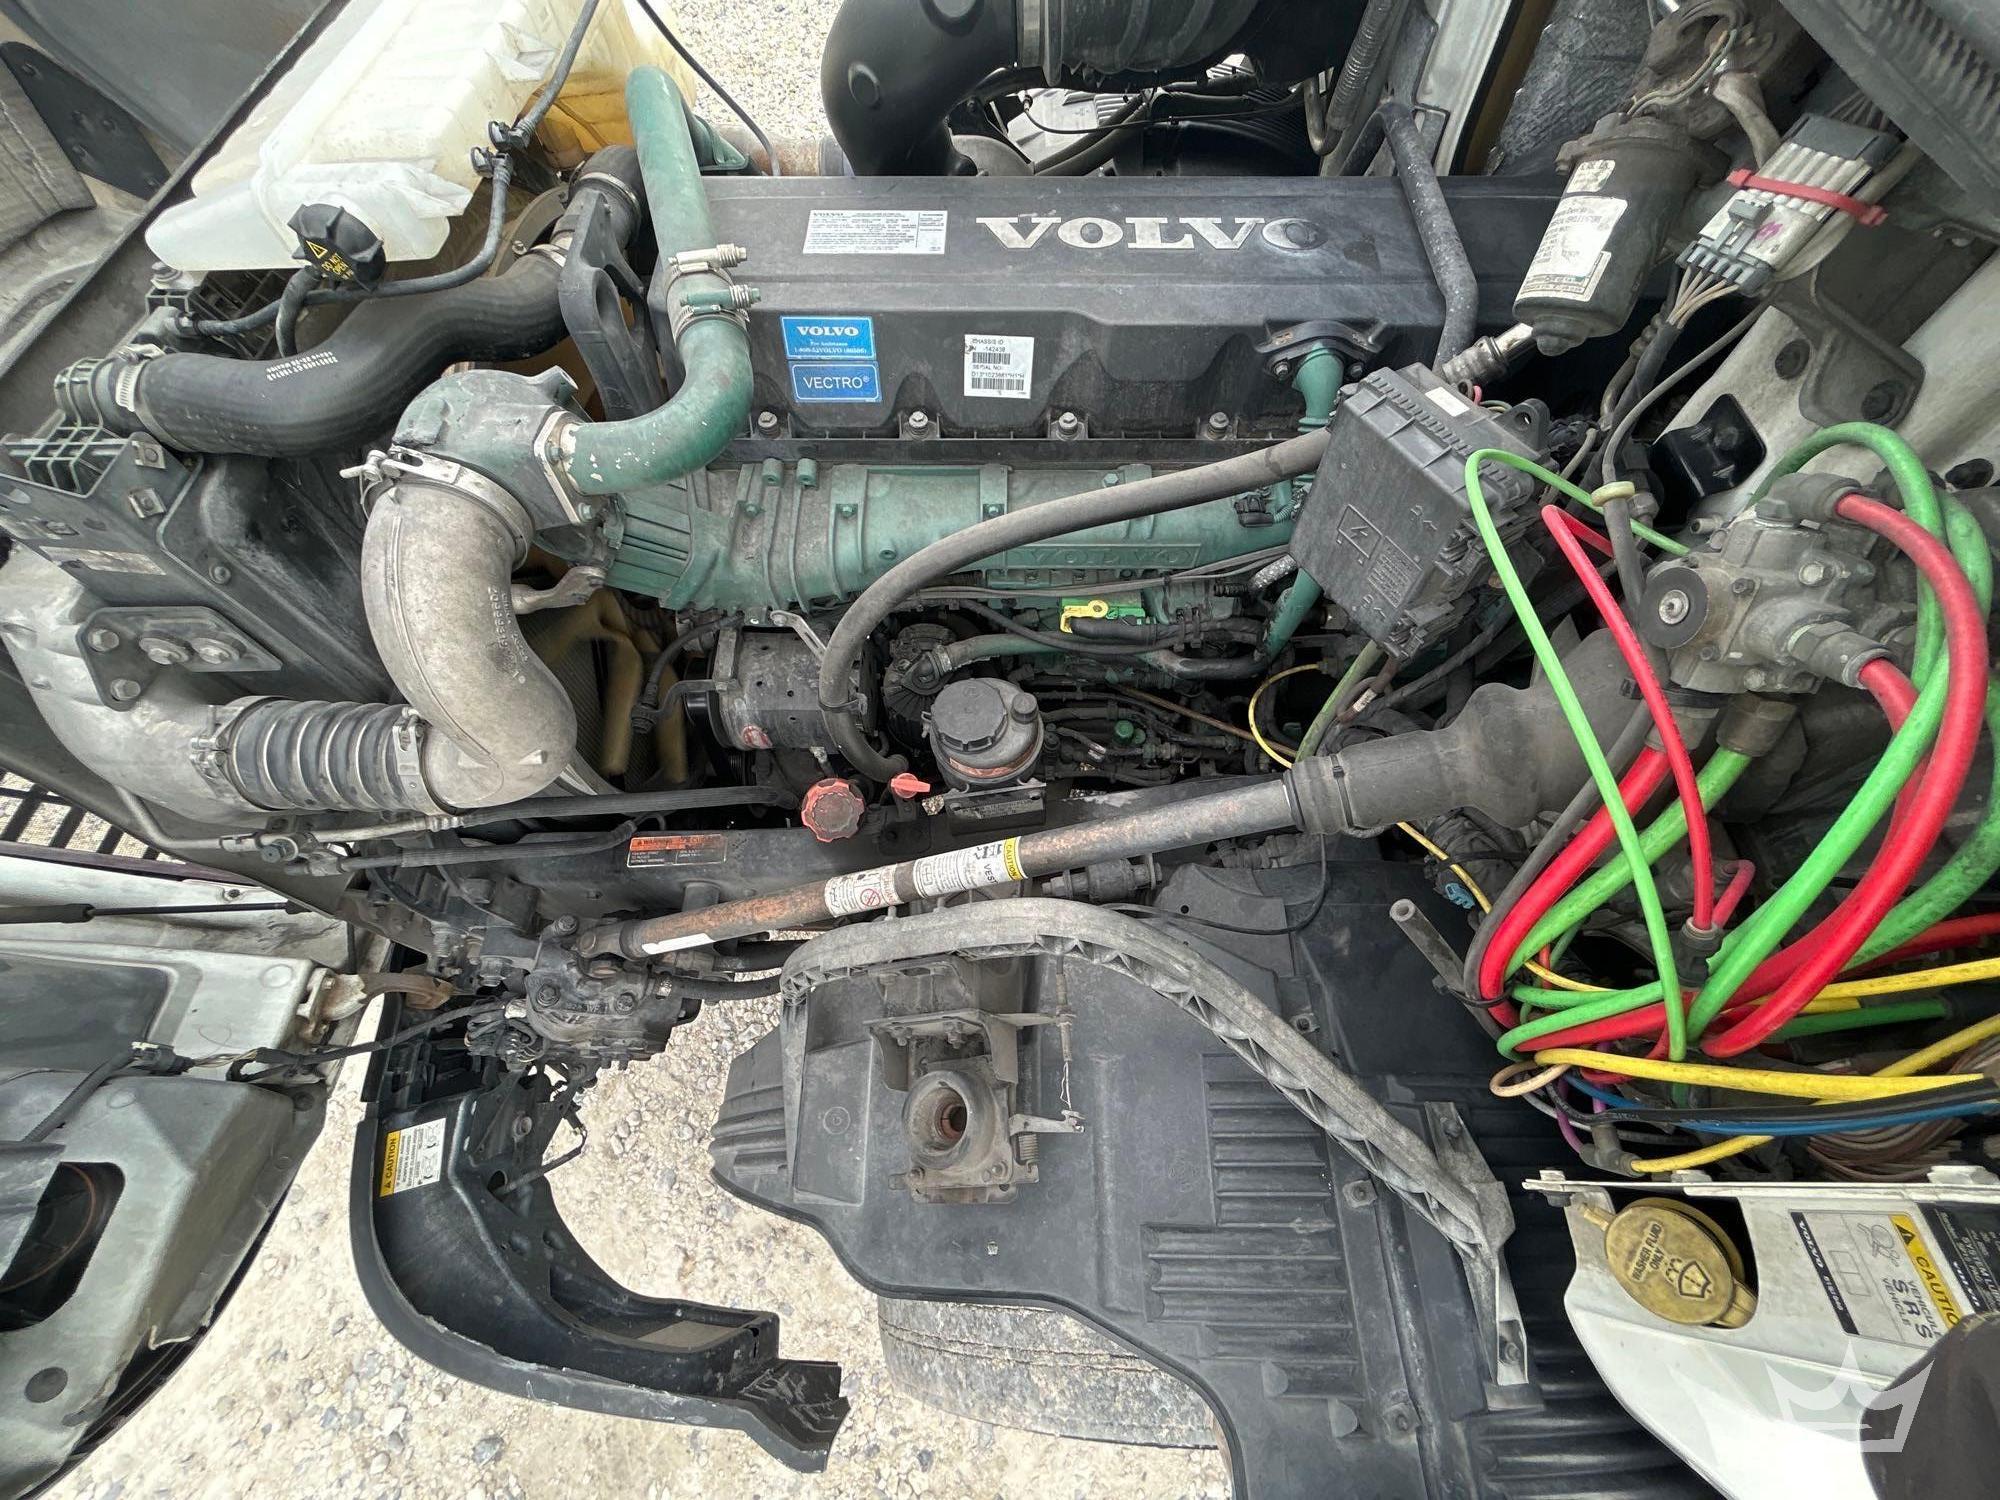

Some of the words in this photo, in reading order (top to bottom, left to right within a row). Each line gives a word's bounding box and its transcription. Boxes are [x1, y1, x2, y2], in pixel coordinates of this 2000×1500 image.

[976, 217, 1328, 250] VOLVO
[796, 326, 859, 337] VOLVO
[385, 1138, 397, 1179] CAUTION
[1631, 1247, 1652, 1281] WASHER
[1645, 1223, 1662, 1249] FLUID
[1649, 1246, 1665, 1270] ONLY
[1799, 1220, 1824, 1268] VOLVO
[1882, 1278, 1912, 1327] VEHICLE
[1916, 1256, 1961, 1326] CAUTIO
